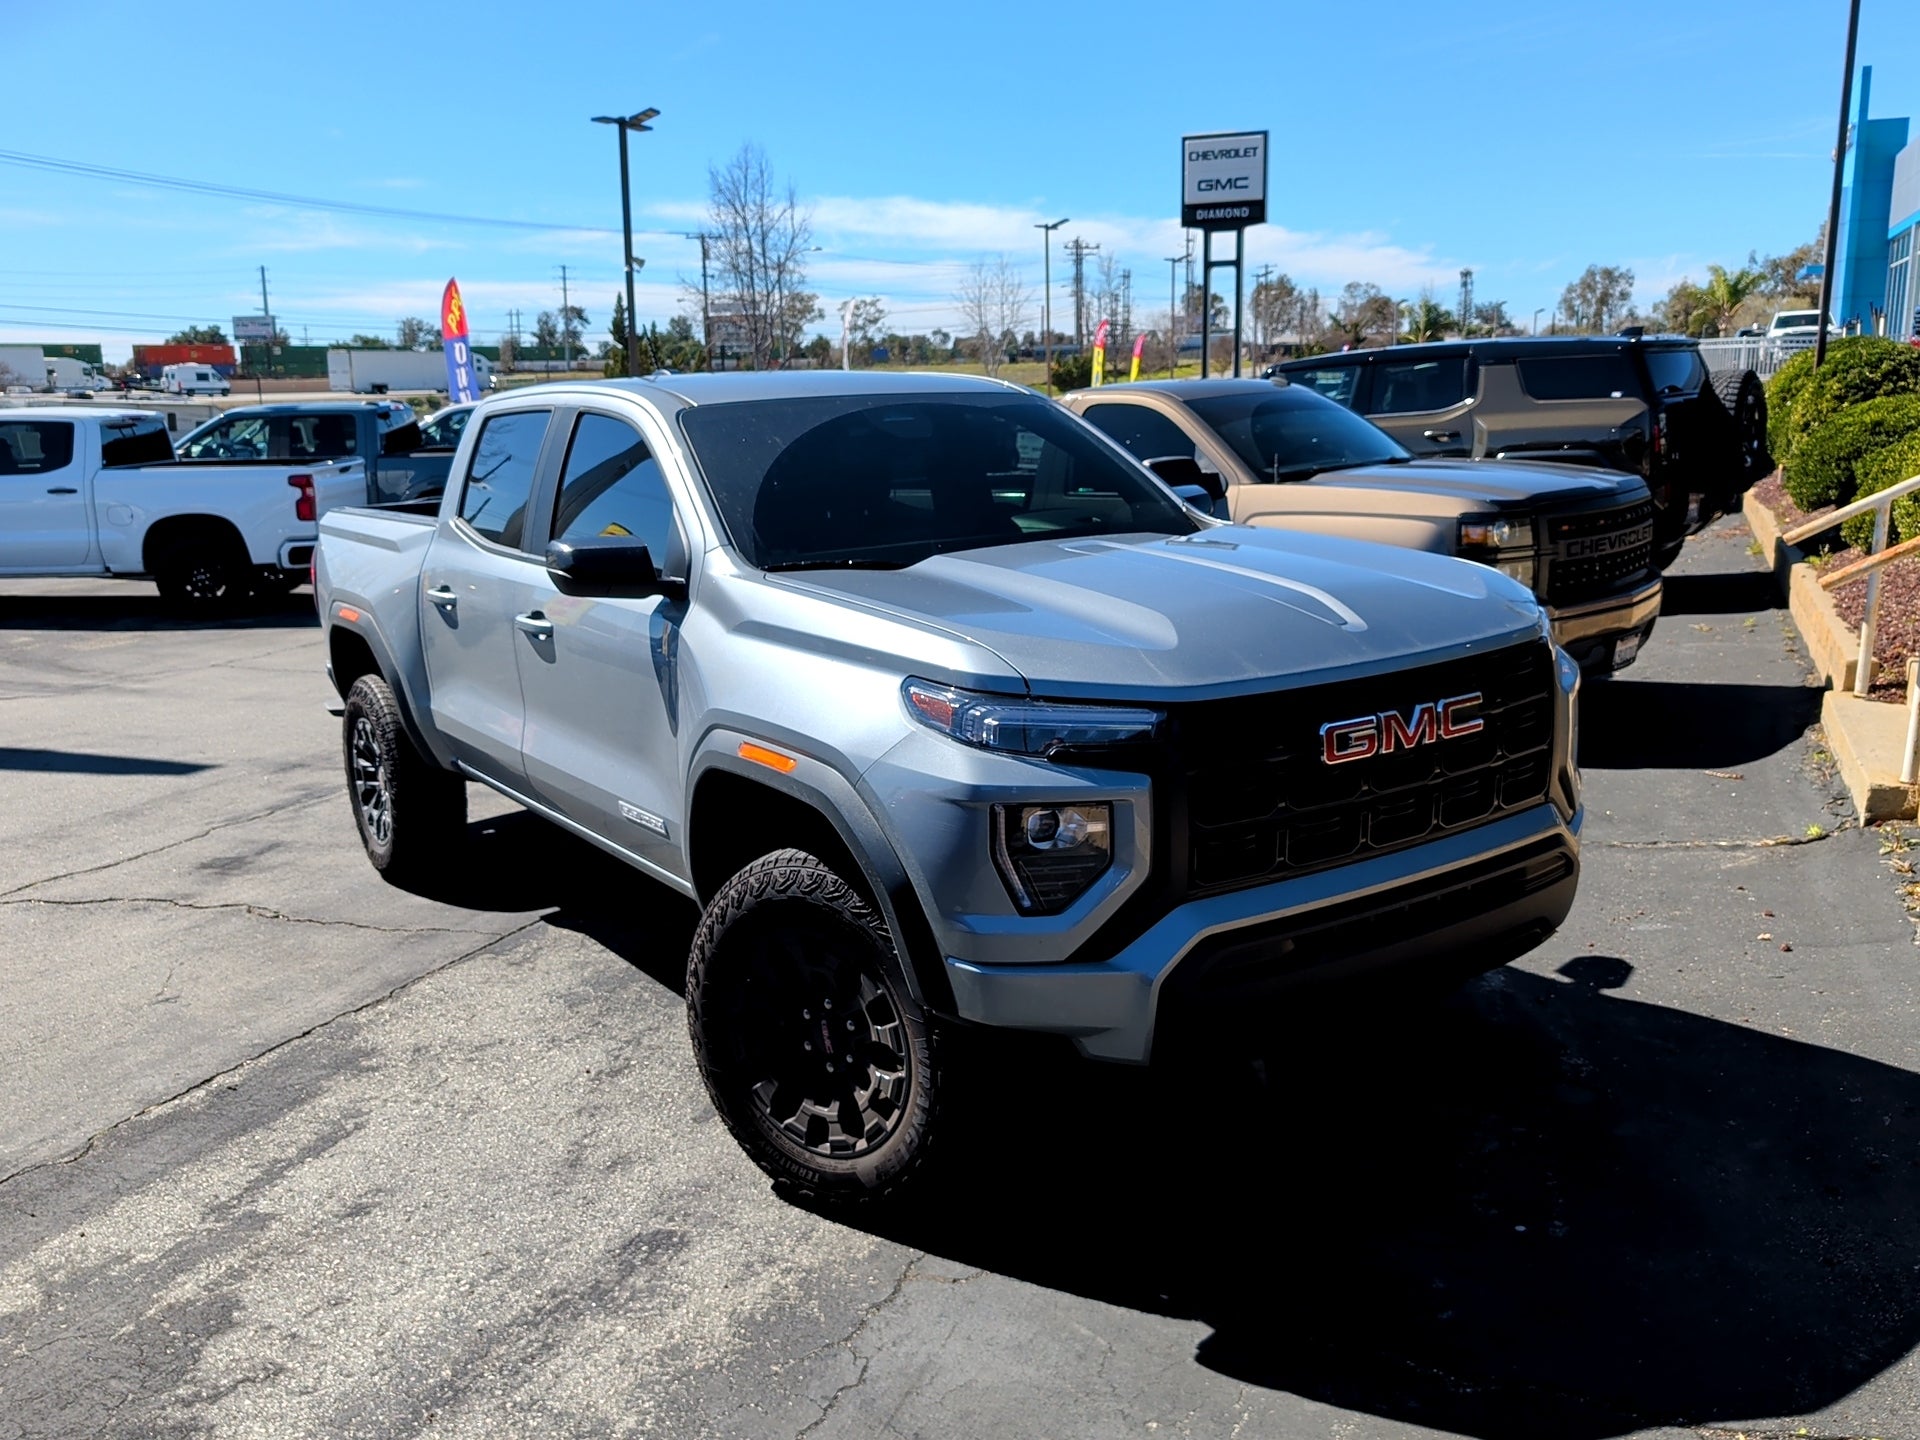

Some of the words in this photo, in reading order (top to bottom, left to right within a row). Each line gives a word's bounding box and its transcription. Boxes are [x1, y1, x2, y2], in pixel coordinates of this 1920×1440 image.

[1188, 147, 1258, 162] CHEVROLET
[1197, 176, 1249, 192] GMC
[1196, 206, 1250, 220] DIAMOND
[1319, 691, 1484, 765] GMC
